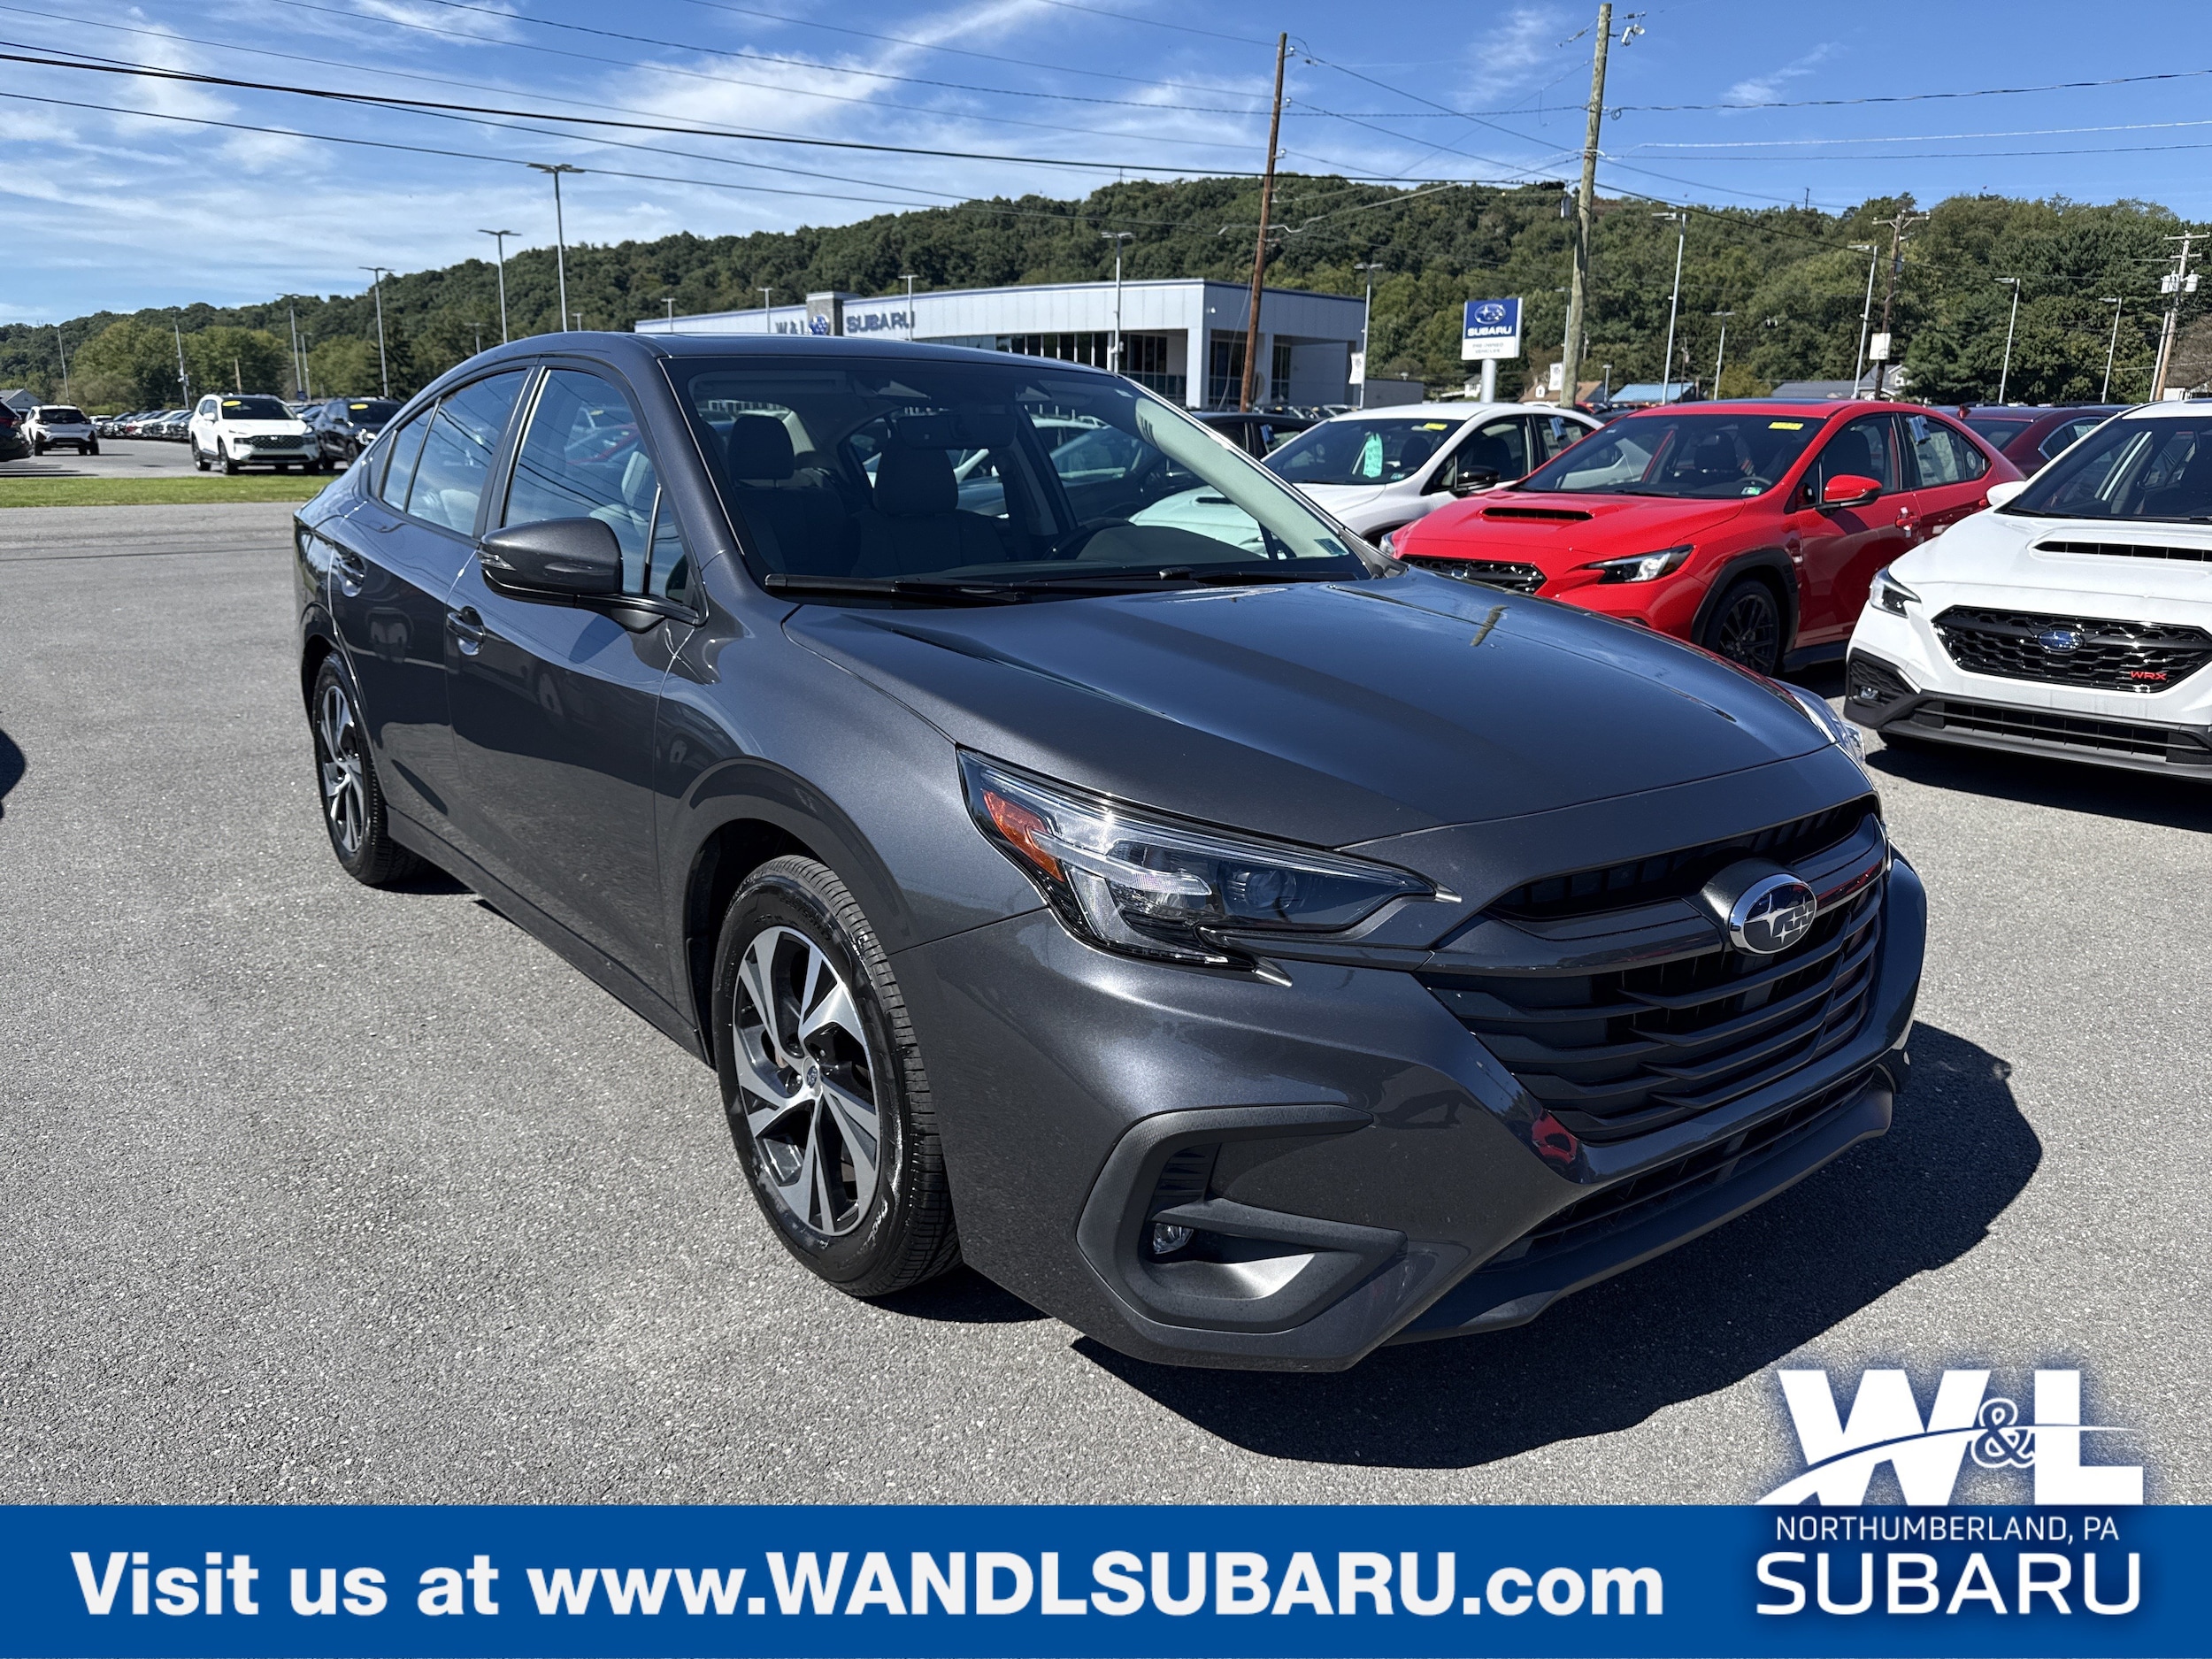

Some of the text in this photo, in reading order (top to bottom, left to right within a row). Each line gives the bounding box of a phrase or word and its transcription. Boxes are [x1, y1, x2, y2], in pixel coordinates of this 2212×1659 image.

[846, 311, 915, 334] SUBARU
[1467, 326, 1513, 337] SUBARU
[2130, 671, 2167, 681] WRX
